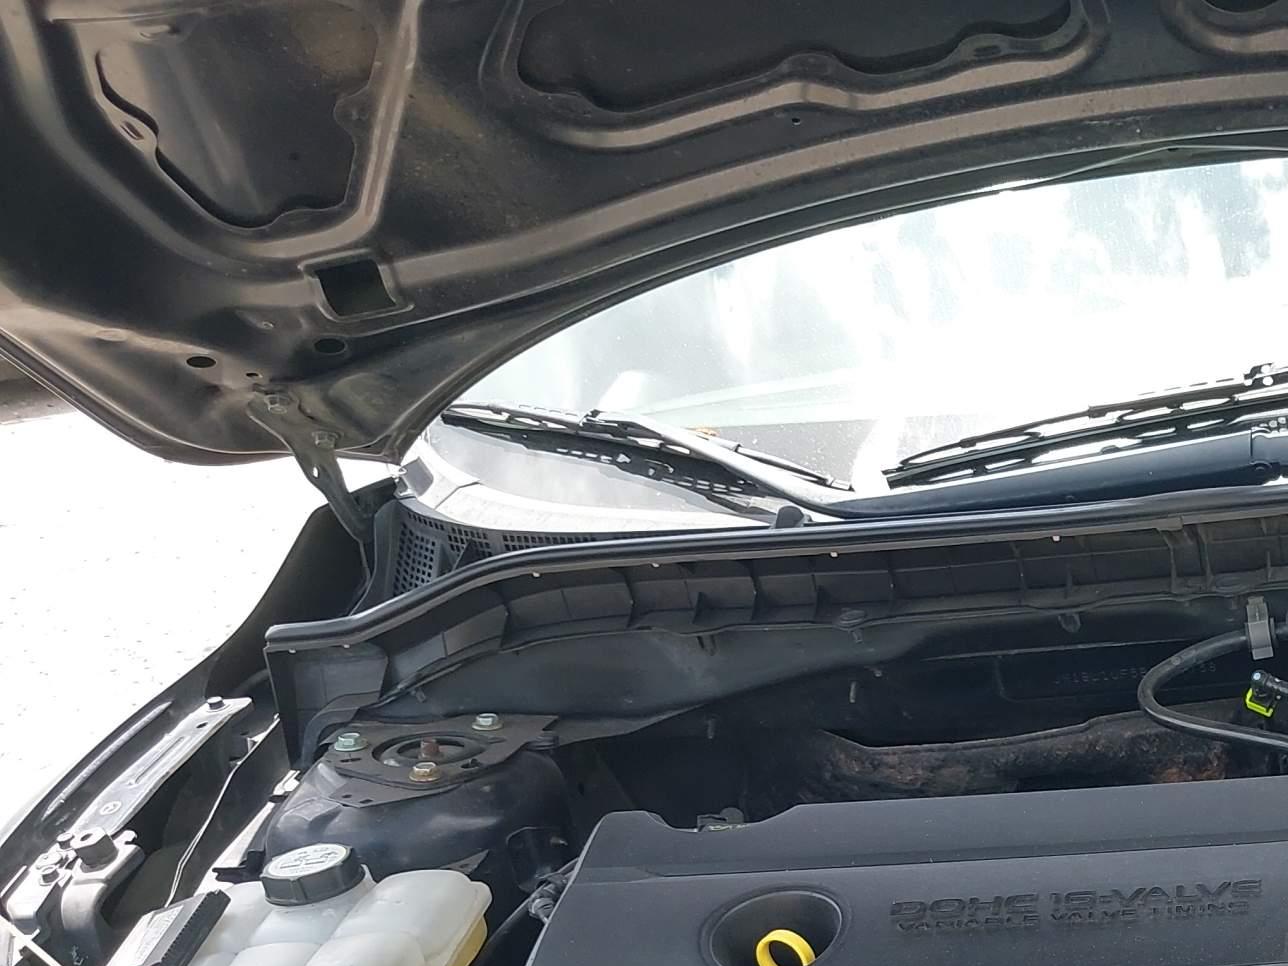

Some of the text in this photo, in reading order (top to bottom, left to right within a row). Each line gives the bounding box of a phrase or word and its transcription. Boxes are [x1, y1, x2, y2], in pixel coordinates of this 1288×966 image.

[889, 879, 1262, 920] DOHC 16-VALVE
[898, 900, 1250, 932] VARIABLE VALVE TIMING
